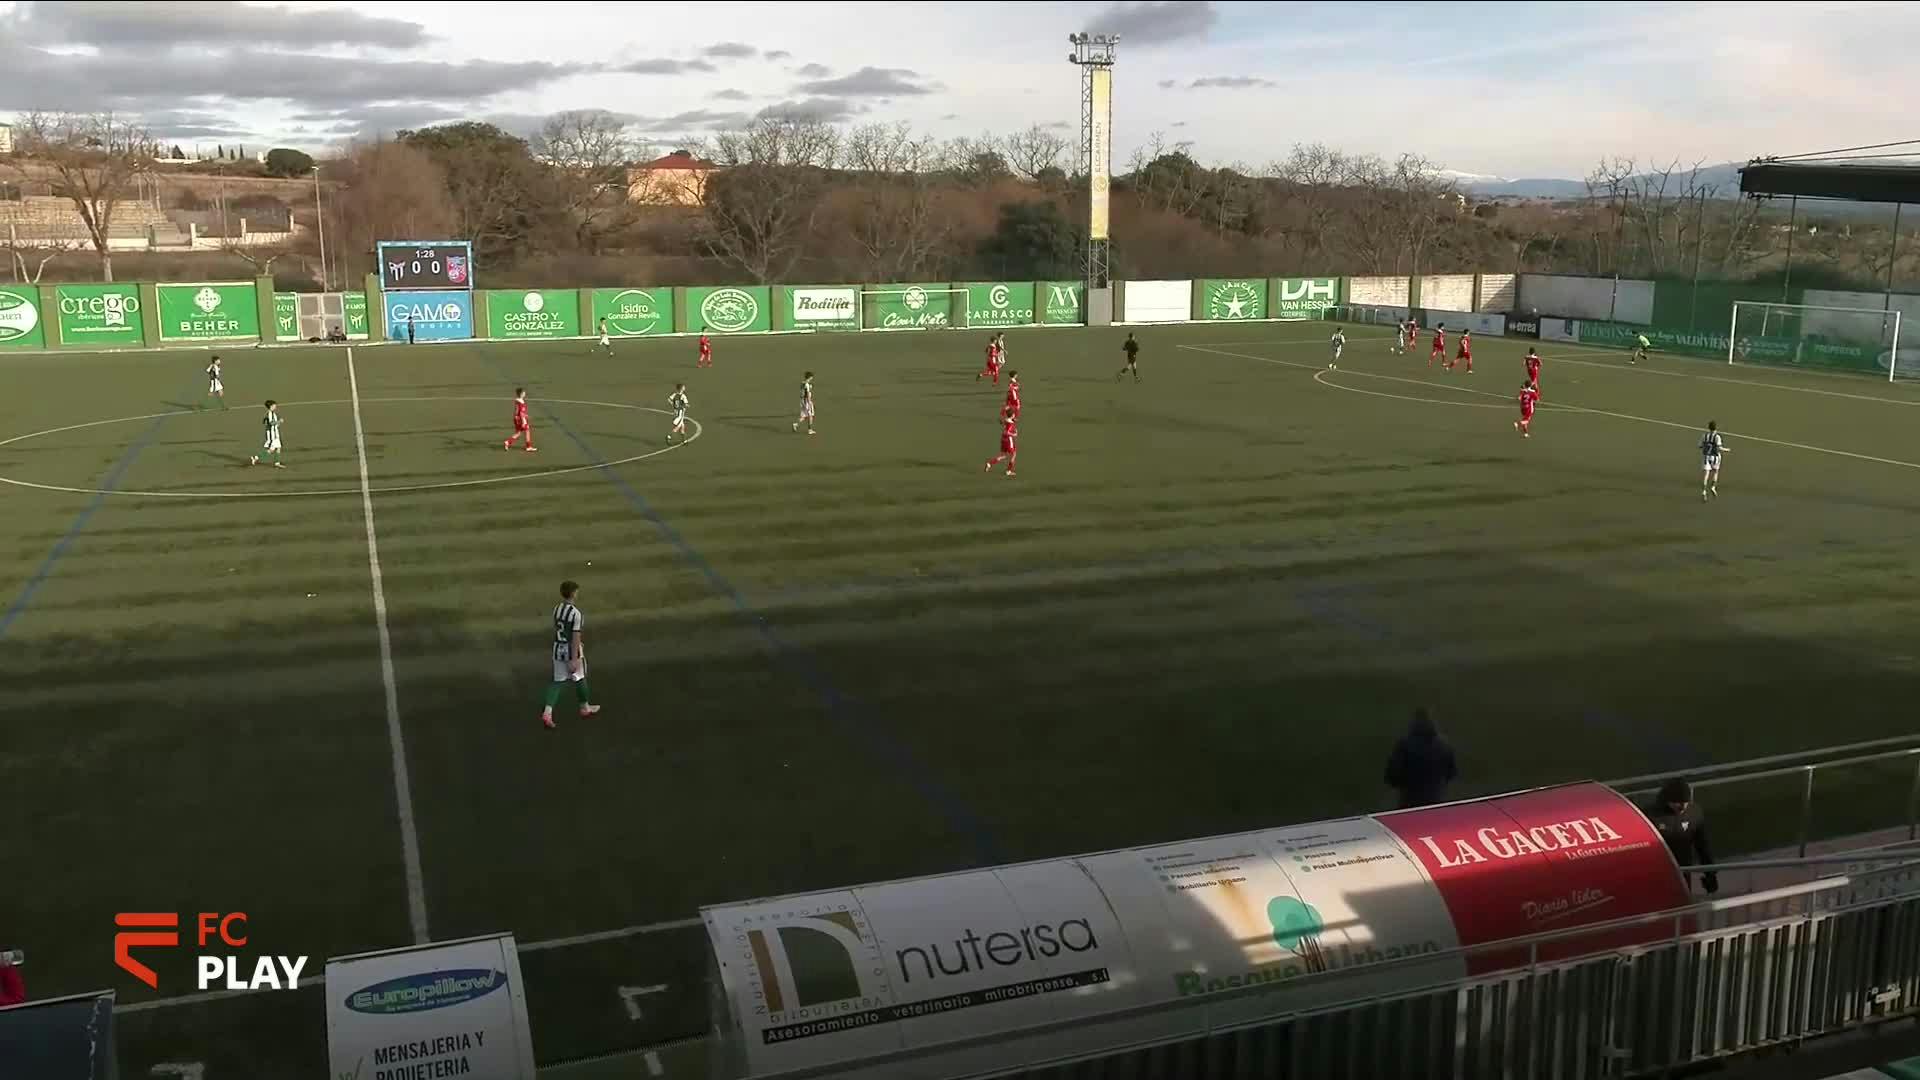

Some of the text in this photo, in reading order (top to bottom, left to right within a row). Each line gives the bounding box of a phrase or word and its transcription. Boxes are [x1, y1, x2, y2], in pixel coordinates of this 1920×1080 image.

[415, 250, 435, 258] 1:28
[412, 261, 440, 274] 0 0
[61, 296, 140, 320] crego
[620, 303, 648, 313] Isidro
[798, 296, 849, 310] Rodilla
[1281, 301, 1299, 310] VAN
[504, 312, 559, 321] CASTRO Y
[181, 321, 239, 331] BEHER
[505, 321, 565, 331] GONZÁLEZ
[1418, 816, 1623, 868] LA GACETA
[896, 917, 1098, 983] nutersa
[352, 967, 497, 1009] Europillow
[767, 1011, 880, 1042] Asesoramiento
[894, 995, 972, 1018] veterinario
[374, 1030, 485, 1066] MENSAJERIA Y
